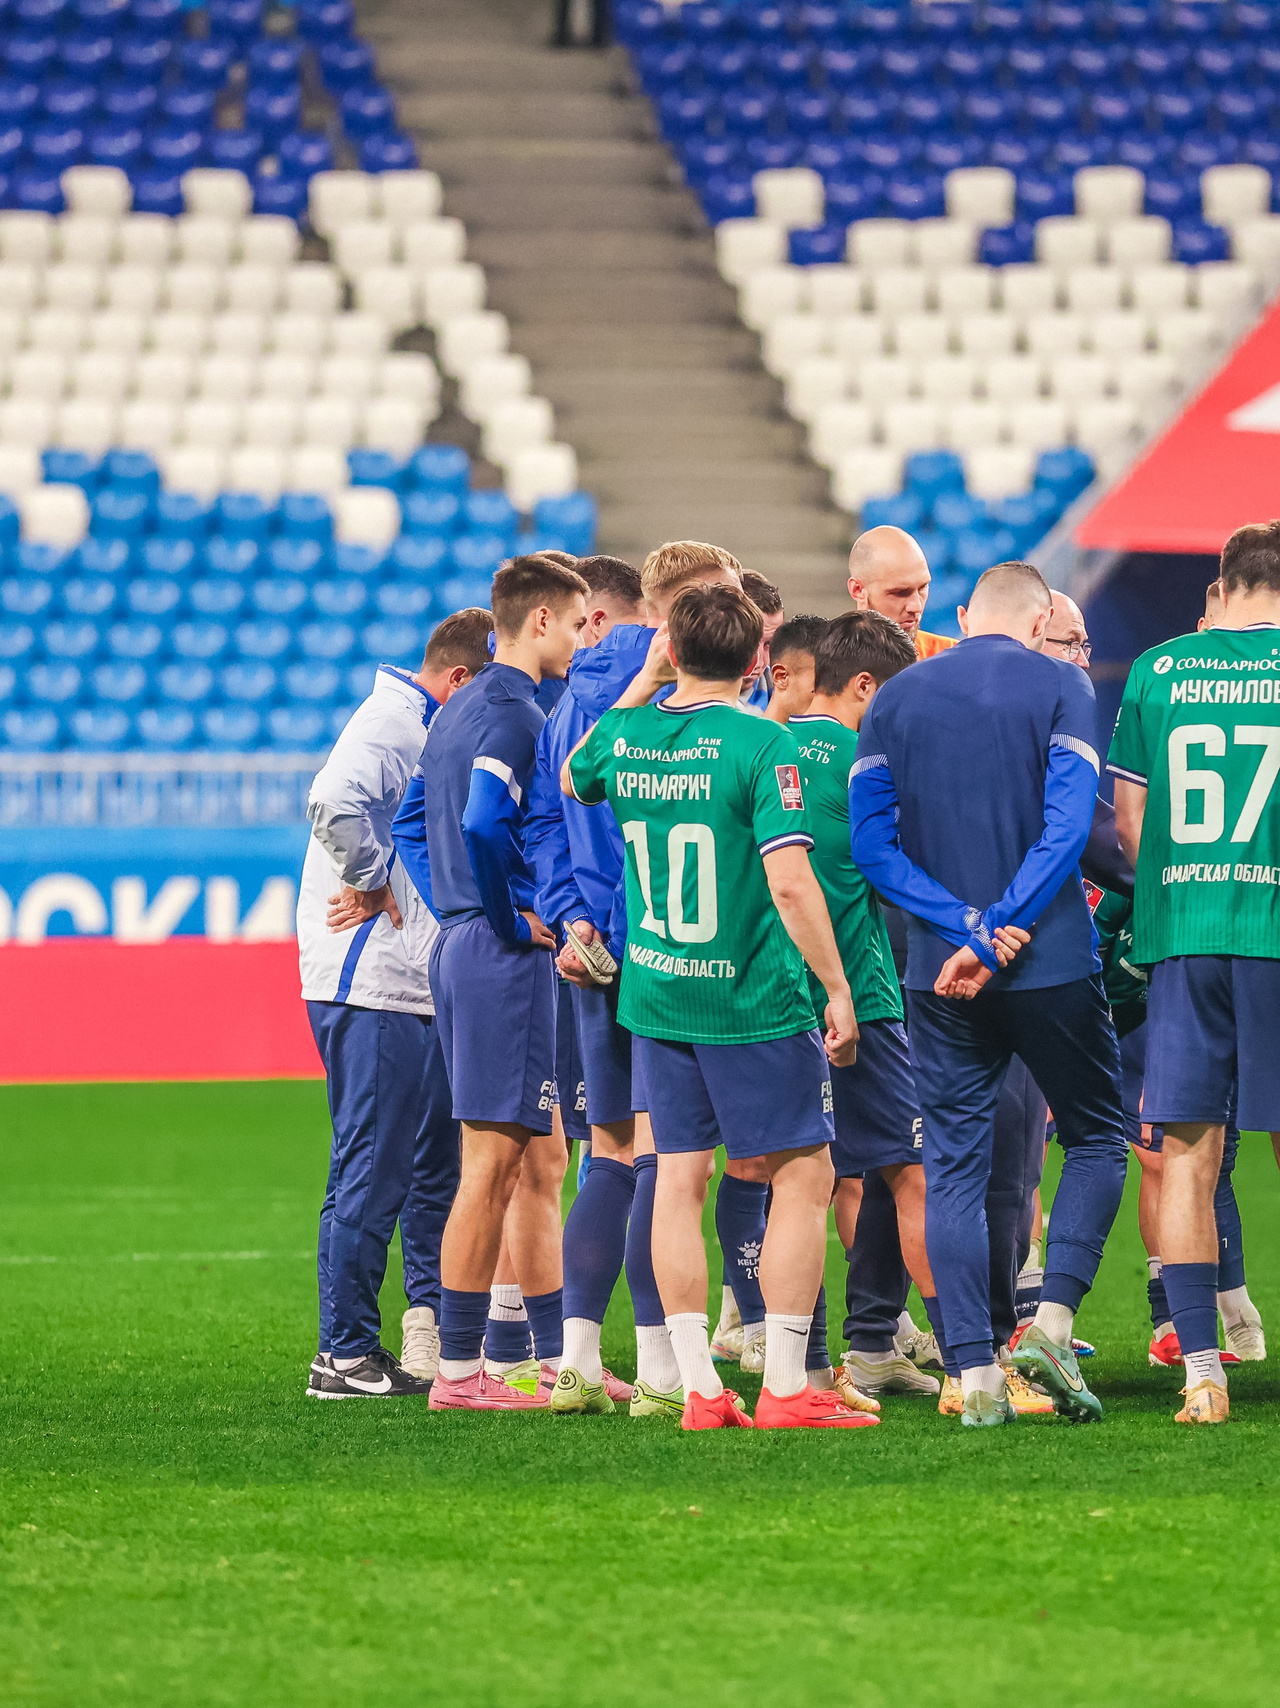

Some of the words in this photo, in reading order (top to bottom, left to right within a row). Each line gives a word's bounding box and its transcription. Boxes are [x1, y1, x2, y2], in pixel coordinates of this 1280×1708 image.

[698, 737, 722, 746] БАНК
[811, 739, 837, 752] БАНК
[626, 746, 719, 762] СОЛИДАРНОСТЬ
[616, 771, 711, 800] КРАМАРИЧ
[622, 820, 718, 943] 10
[1162, 863, 1231, 885] САМАРСКАЯ
[0, 872, 295, 945] СКИ
[674, 957, 736, 978] ОБЛАСТЬ
